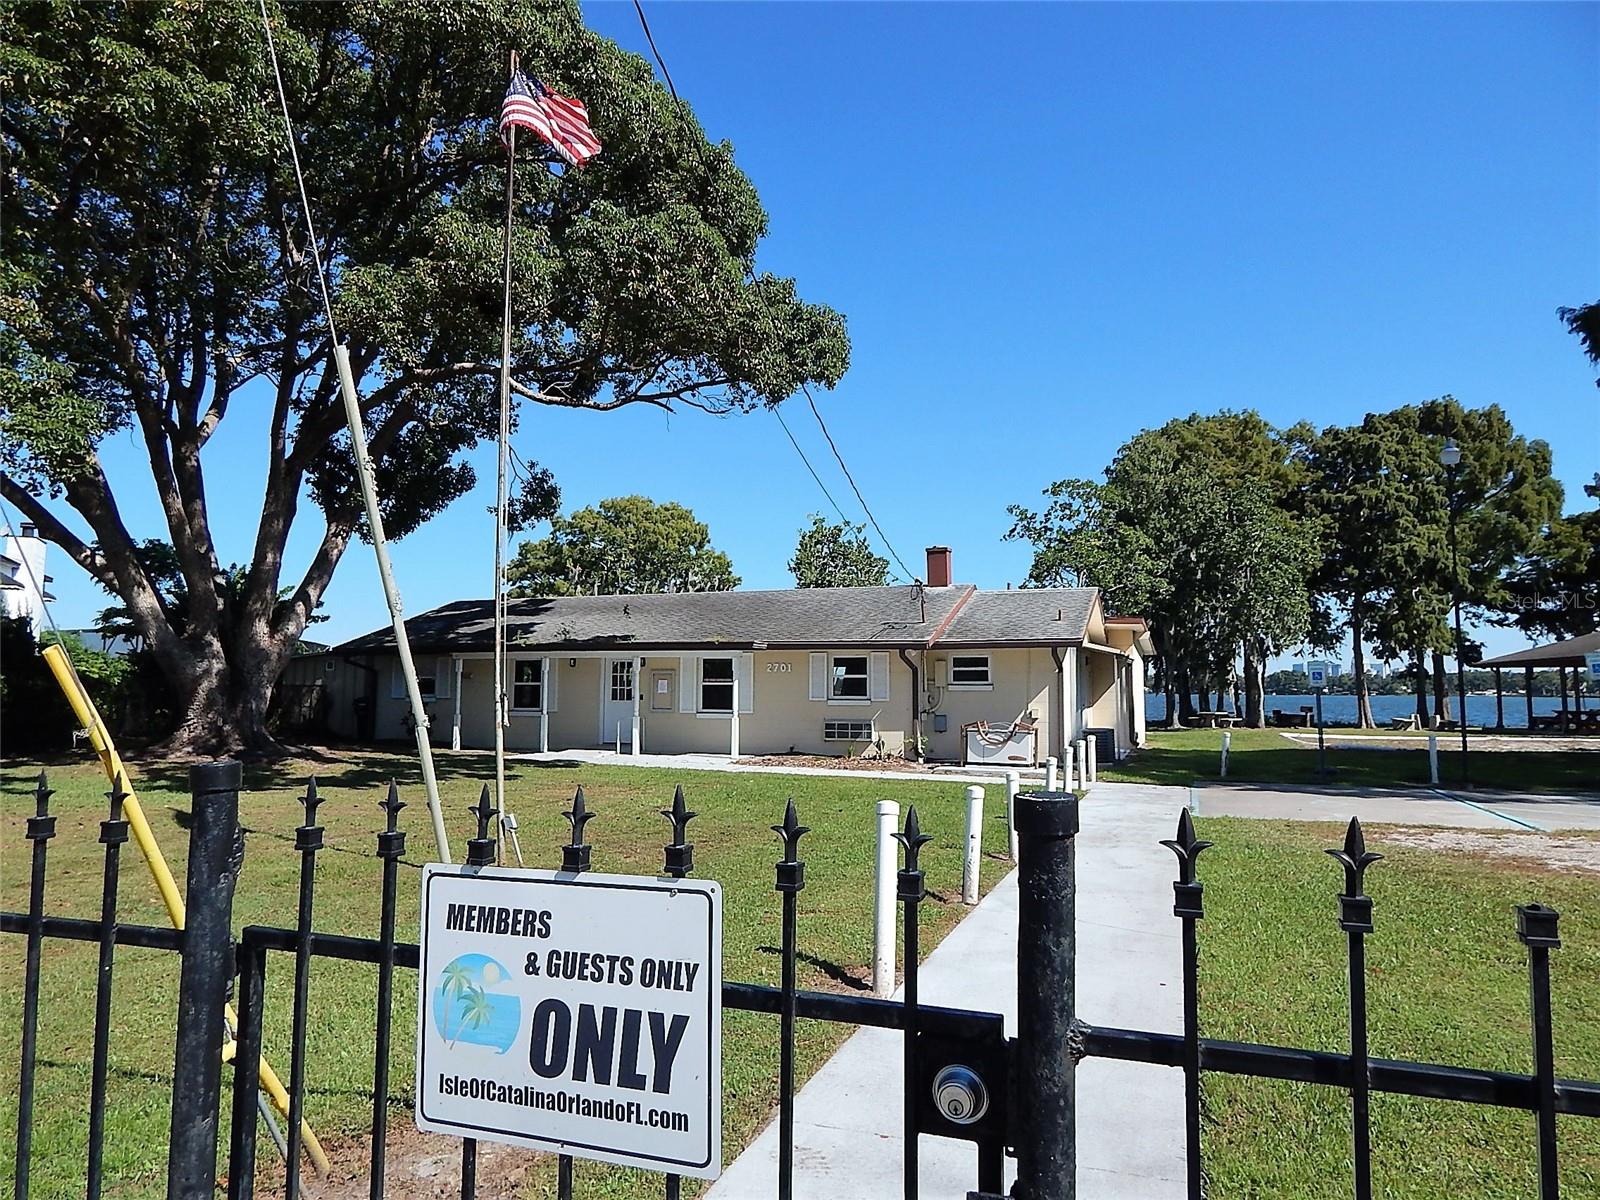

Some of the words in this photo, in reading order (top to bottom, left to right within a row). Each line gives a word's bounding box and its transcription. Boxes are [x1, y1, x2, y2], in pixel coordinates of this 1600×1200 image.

[767, 663, 792, 673] 2701
[445, 903, 553, 939] MEMBERS
[524, 952, 540, 977] &
[546, 949, 635, 987] GUESTS
[640, 958, 700, 993] ONLY
[529, 998, 691, 1096] ONLY
[438, 1073, 690, 1133] IsleOfCatalinaOrlandoFL.com
